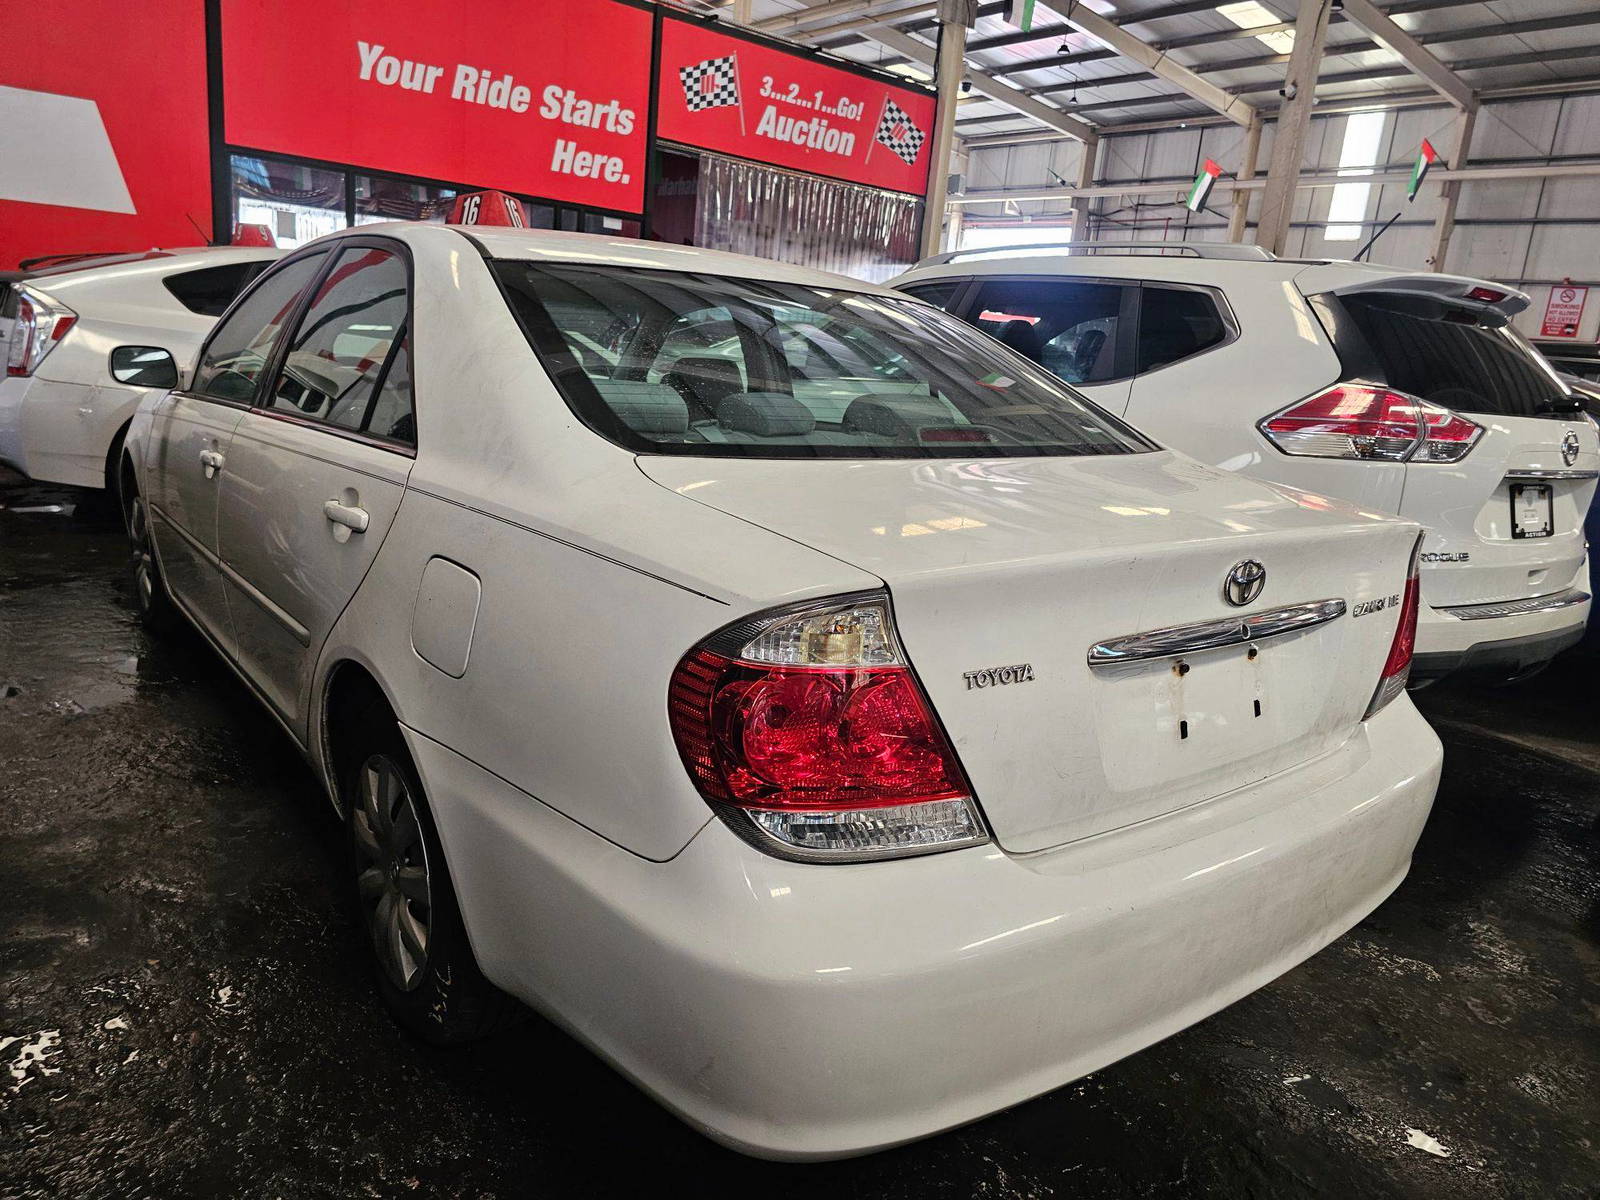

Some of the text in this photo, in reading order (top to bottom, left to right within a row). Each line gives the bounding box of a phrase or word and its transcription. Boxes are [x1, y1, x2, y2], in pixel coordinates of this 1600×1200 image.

[357, 41, 636, 135] Your Ride Starts
[759, 76, 864, 121] 3...2...1...Go!
[756, 105, 856, 157] Auction
[551, 139, 631, 185] Here.
[462, 196, 481, 225] 16
[505, 198, 524, 228] 16
[963, 662, 1035, 690] TOYOTA
